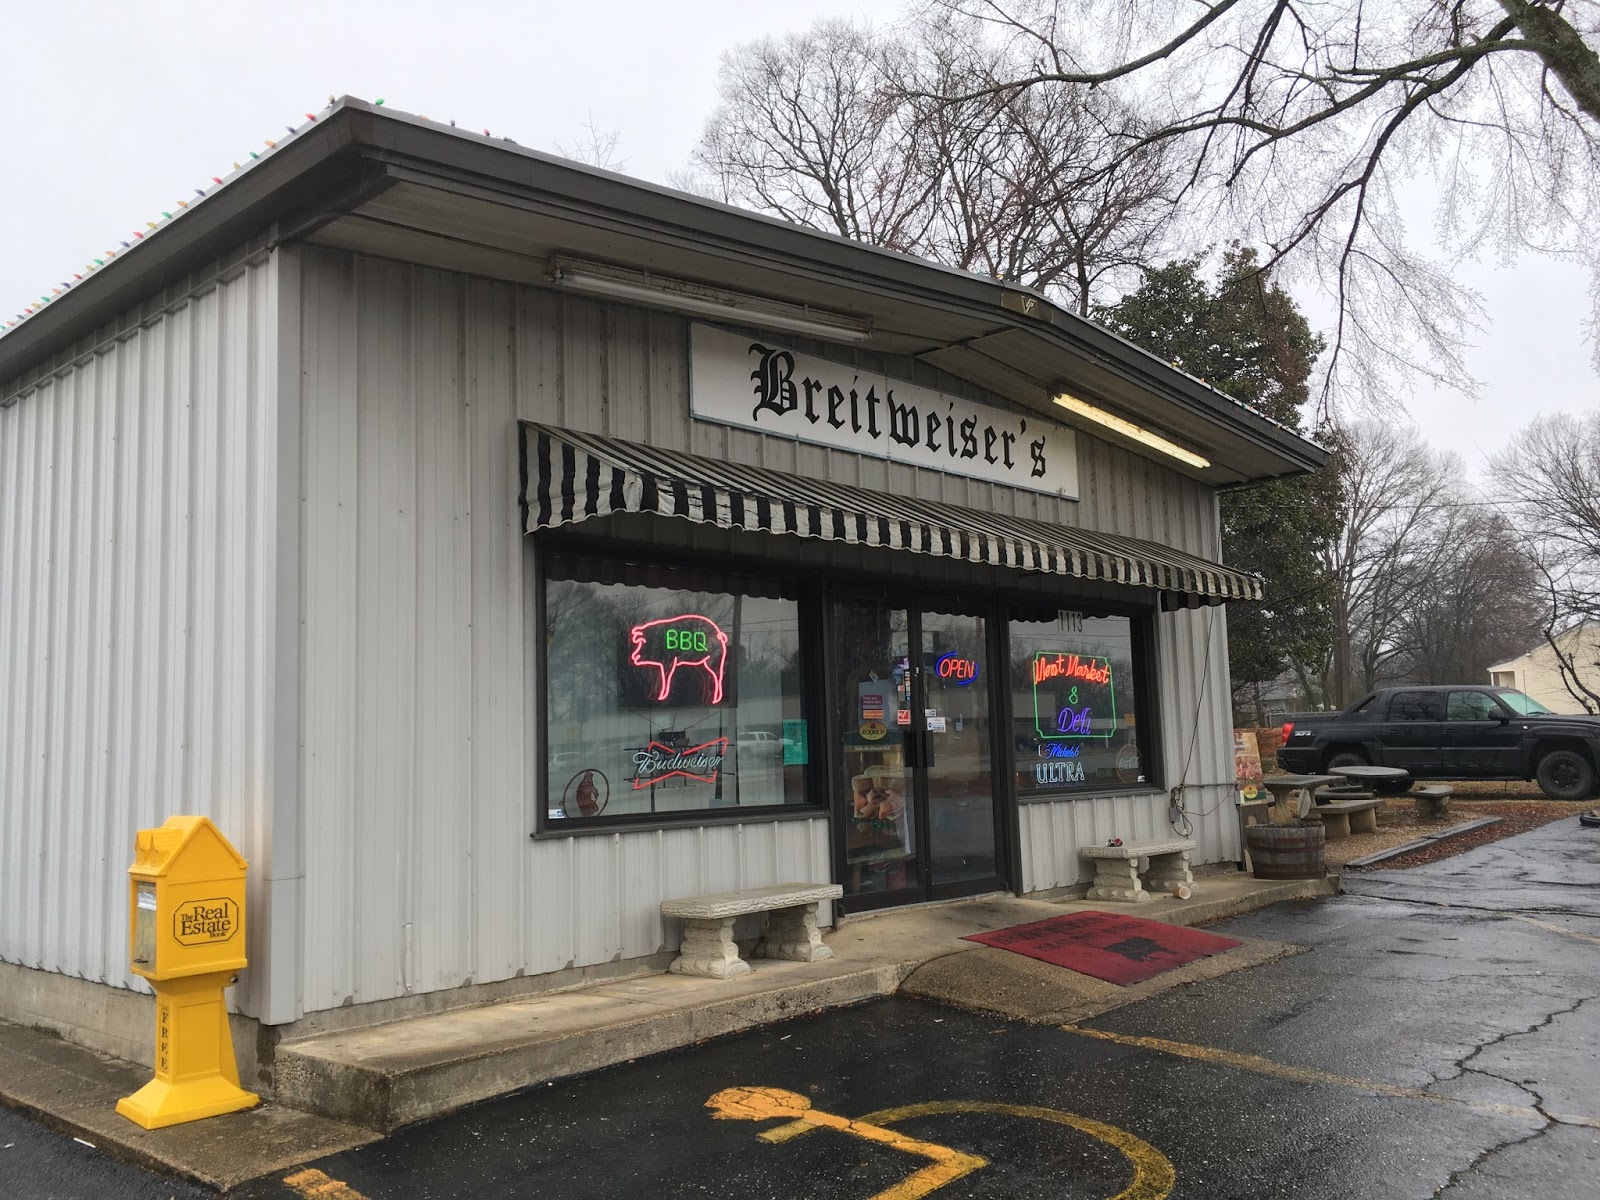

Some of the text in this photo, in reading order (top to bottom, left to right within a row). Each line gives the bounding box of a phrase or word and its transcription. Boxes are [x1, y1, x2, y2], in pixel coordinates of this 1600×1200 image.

[748, 343, 1046, 478] Breitweiser's
[1060, 611, 1082, 632] 1113
[666, 629, 708, 651] BBQ
[940, 659, 975, 678] OPEN
[1034, 653, 1109, 684] Meat Market
[1058, 708, 1091, 734] Deli
[633, 751, 724, 773] Budweiser
[1036, 762, 1085, 784] ULTRA
[193, 903, 229, 921] Real
[181, 919, 231, 936] Estate
[161, 1012, 169, 1070] FREE
